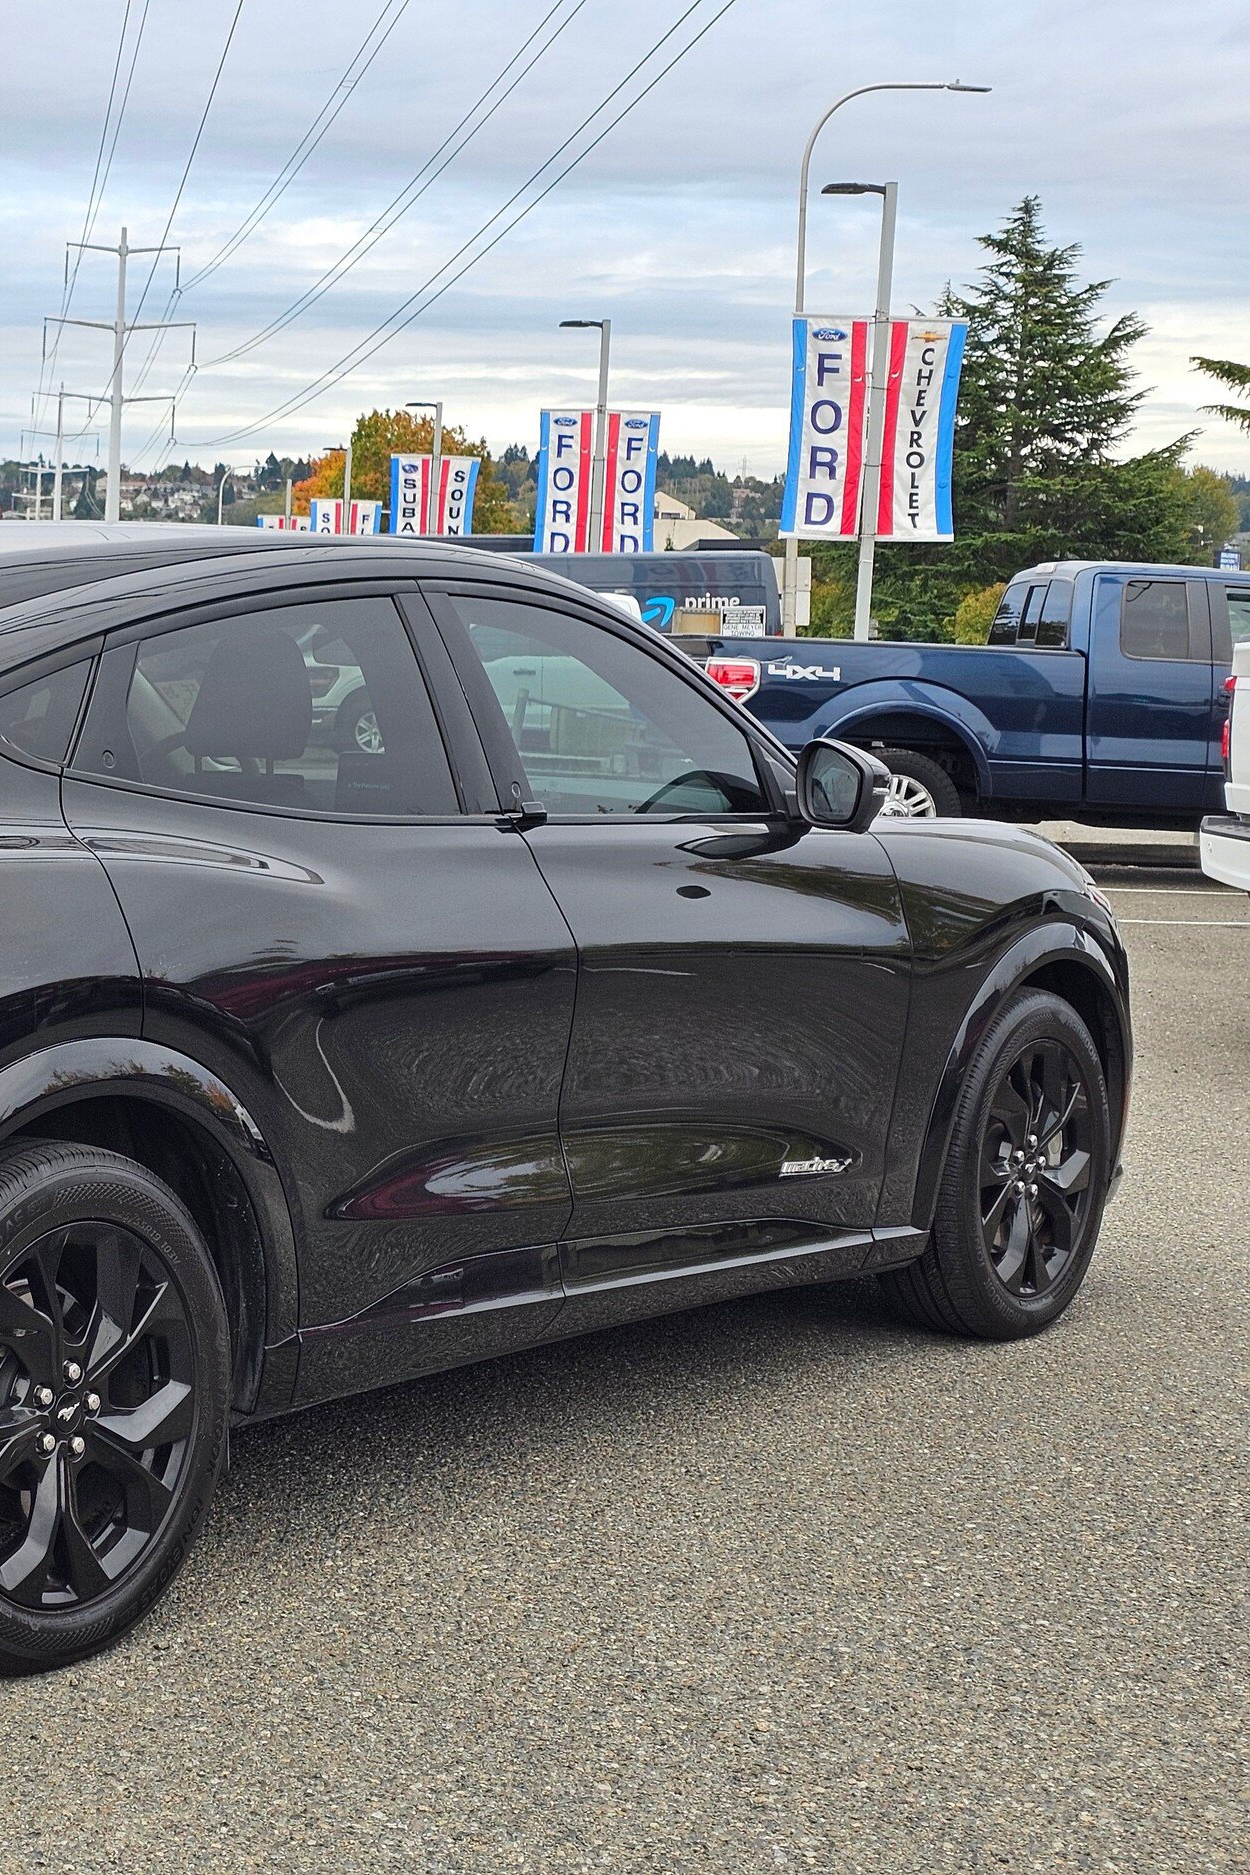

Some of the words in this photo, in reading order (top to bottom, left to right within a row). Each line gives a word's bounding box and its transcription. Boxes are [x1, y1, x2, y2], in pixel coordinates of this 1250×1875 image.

[818, 329, 841, 341] Ford
[550, 434, 574, 552] FORD
[620, 437, 644, 553] FORD
[804, 353, 843, 525] FORD
[905, 348, 936, 528] CHEVROLET
[685, 593, 740, 608] prime
[768, 664, 841, 681] 4X4
